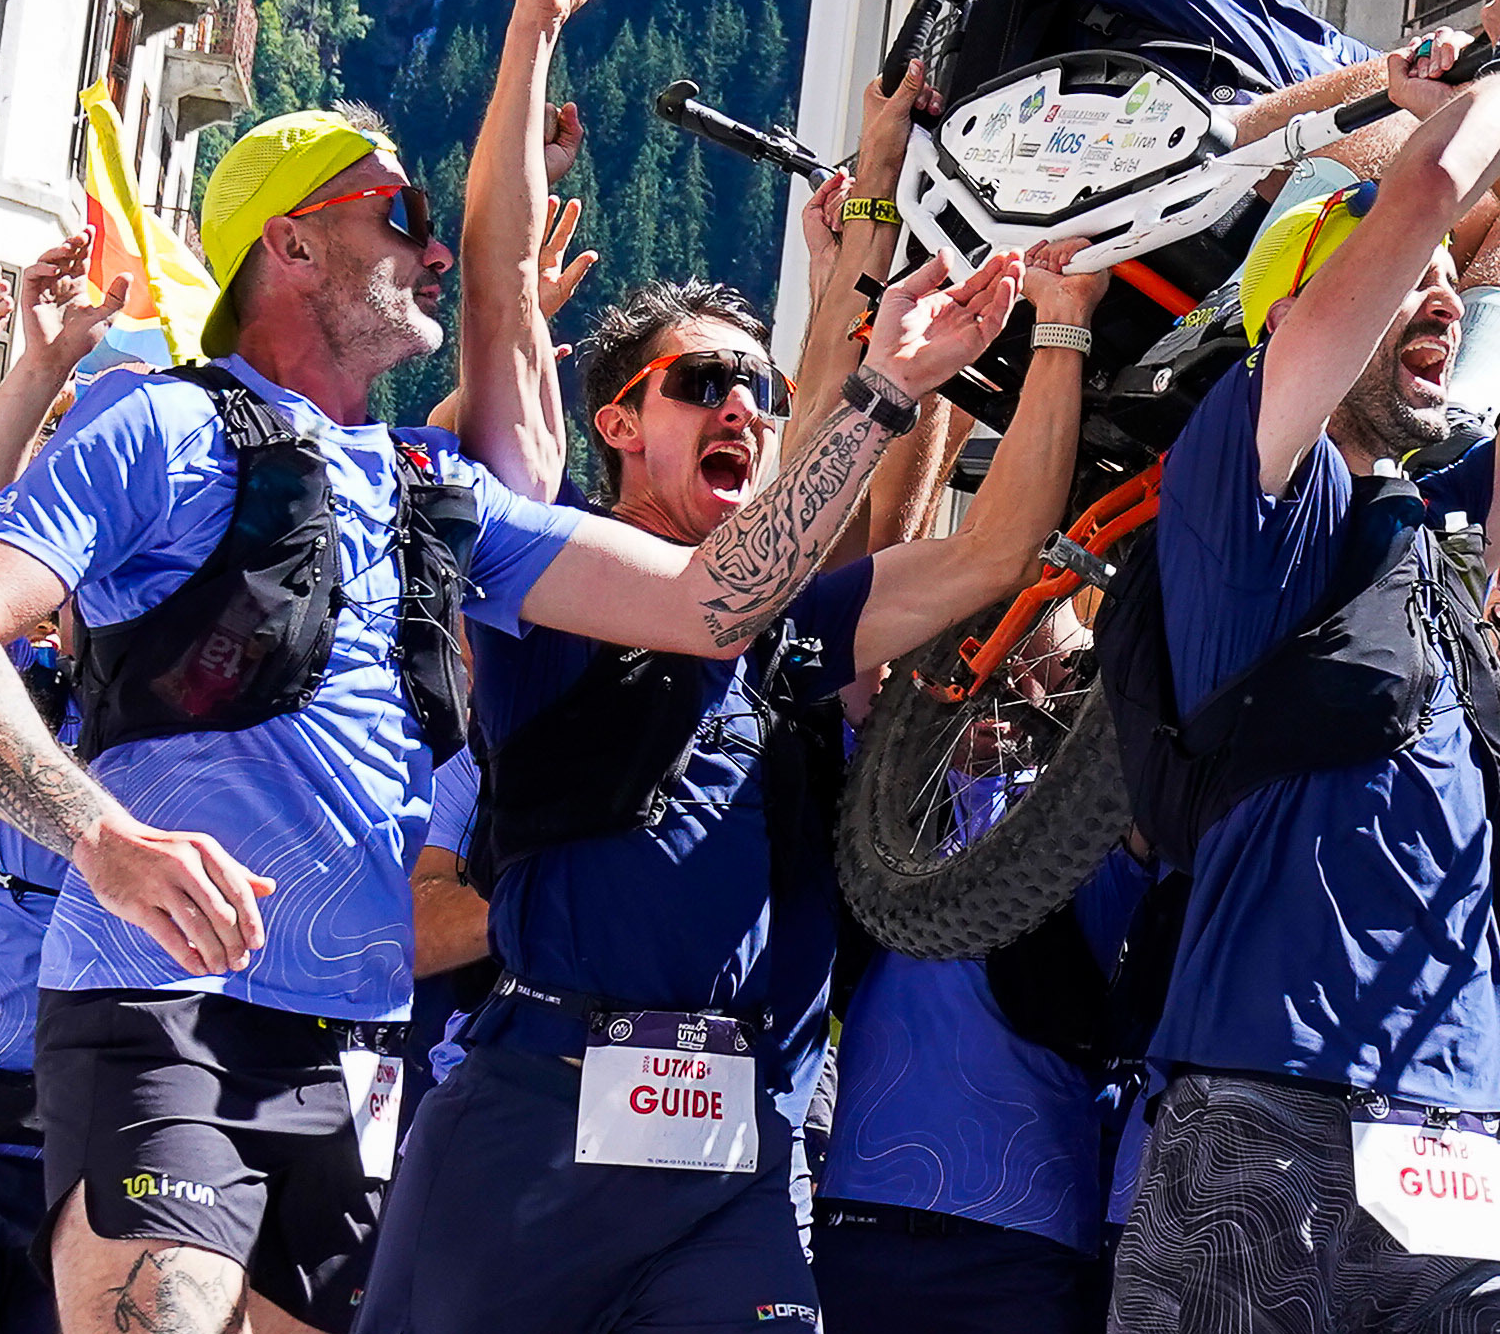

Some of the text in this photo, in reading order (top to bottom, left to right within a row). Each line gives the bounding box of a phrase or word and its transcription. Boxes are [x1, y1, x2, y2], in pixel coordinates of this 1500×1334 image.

[1045, 126, 1086, 155] ikos
[653, 1057, 707, 1080] UTMB
[629, 1085, 724, 1120] GUIDE
[161, 1172, 215, 1207] i-run
[1399, 1166, 1494, 1204] GUIDE
[774, 1304, 816, 1322] OFPS
